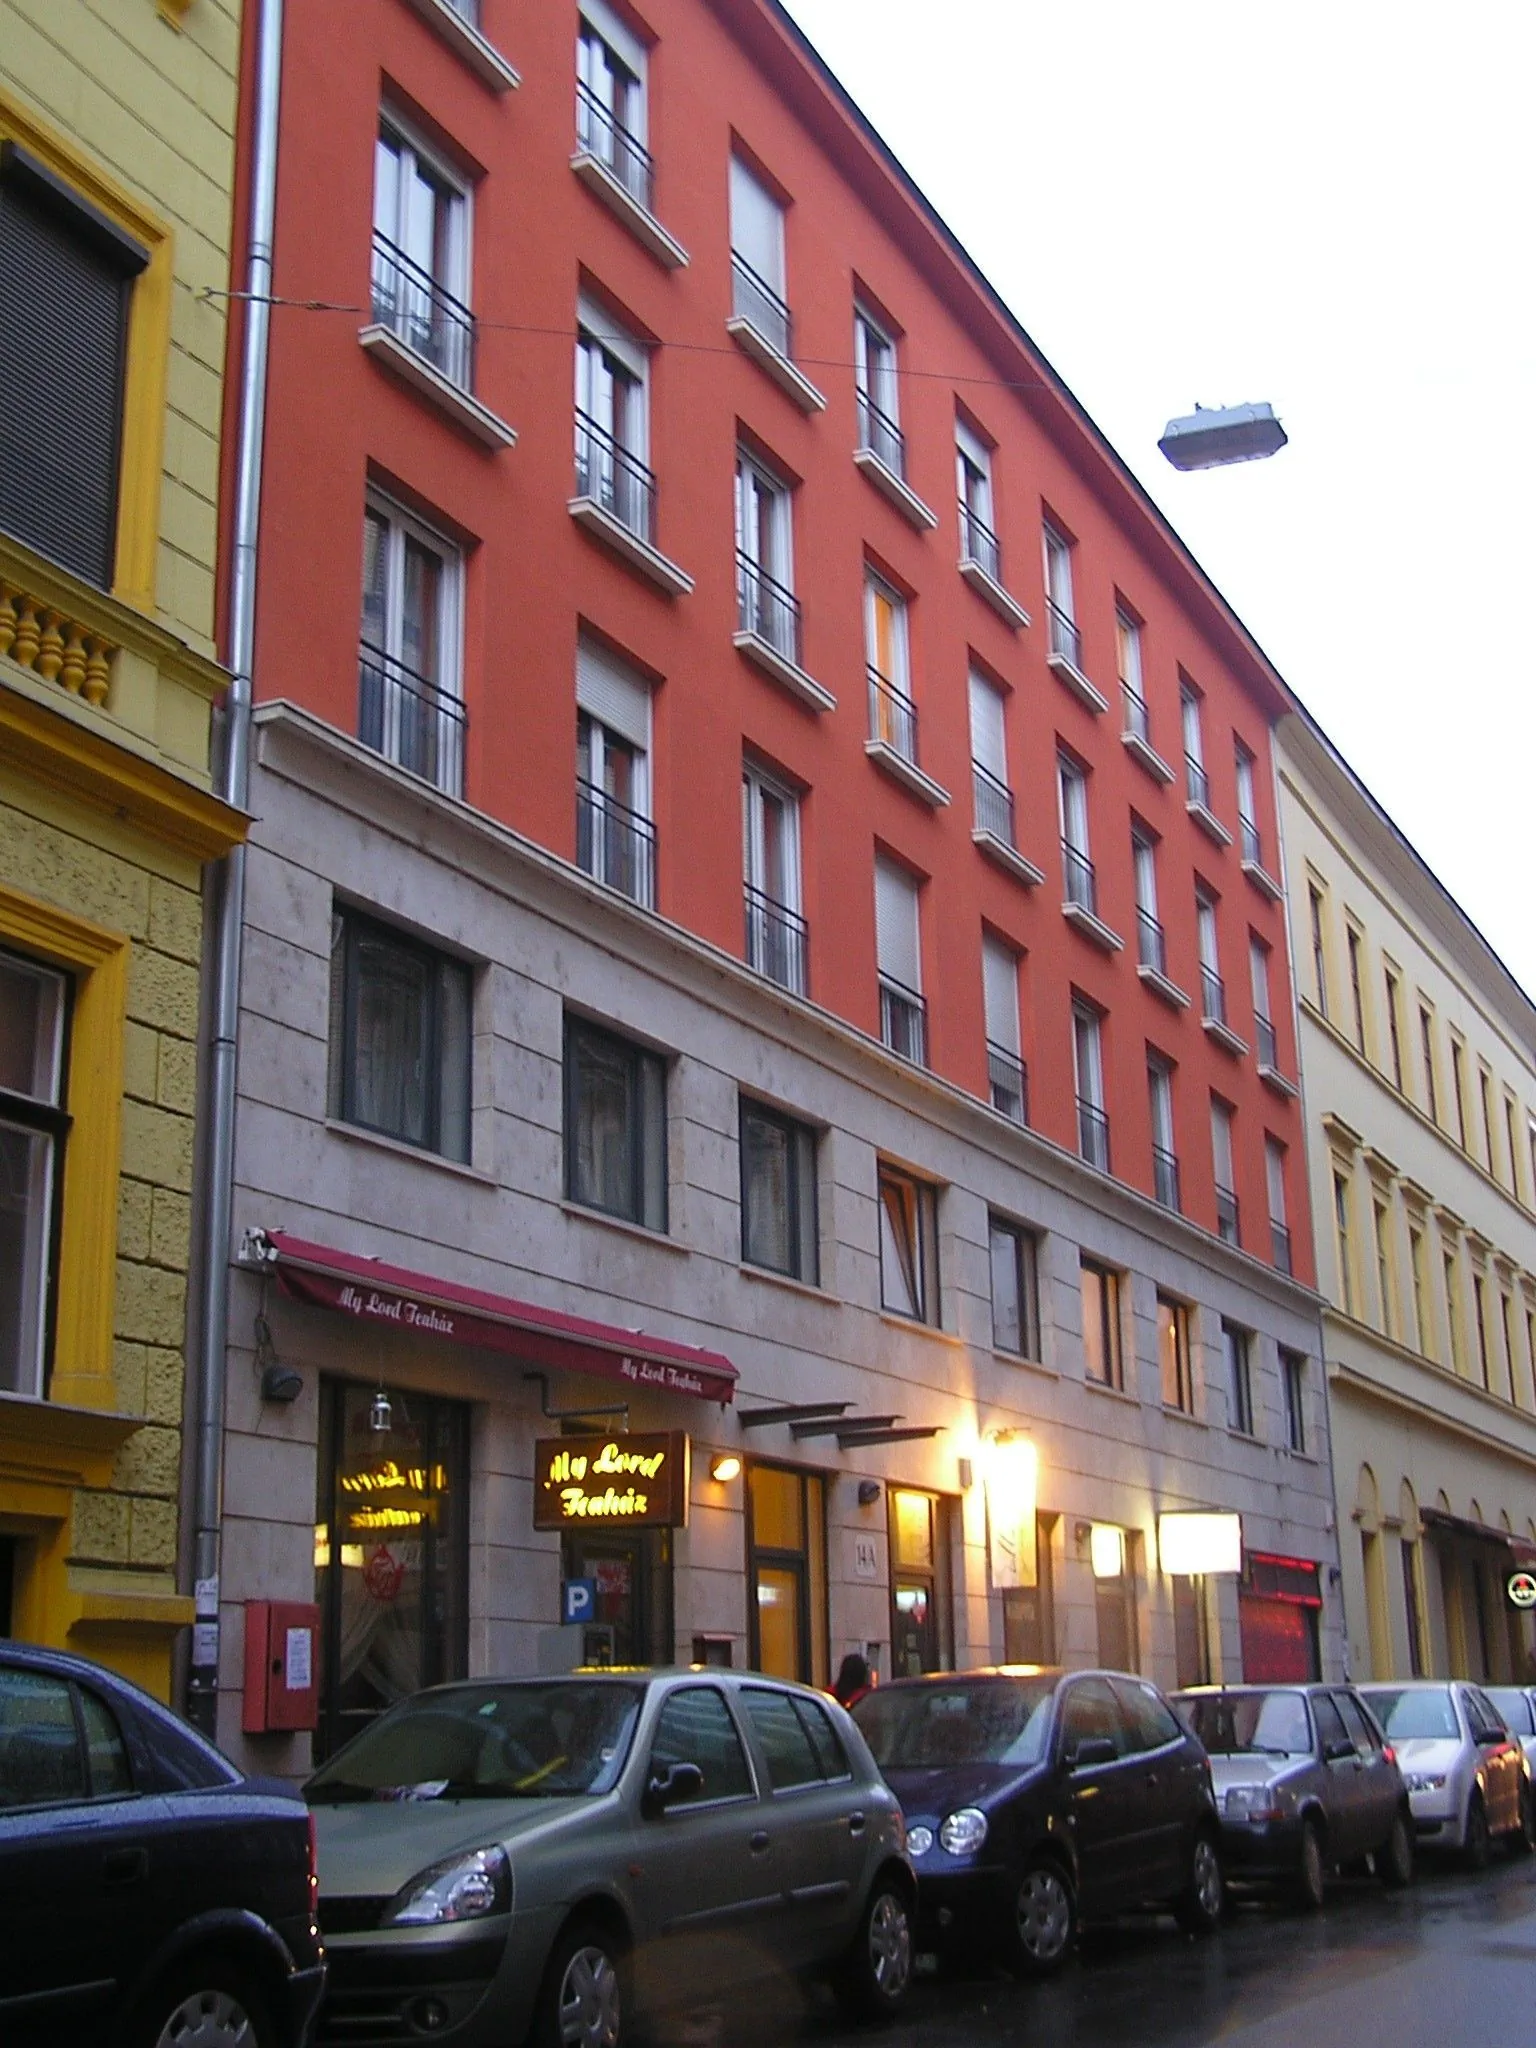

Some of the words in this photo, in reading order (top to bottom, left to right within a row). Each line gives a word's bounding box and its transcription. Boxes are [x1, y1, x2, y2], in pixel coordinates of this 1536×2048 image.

[339, 1286, 362, 1314] My
[365, 1293, 402, 1320] Lord
[544, 1451, 588, 1489] My
[592, 1443, 665, 1479] Lord
[567, 1586, 589, 1617] P
